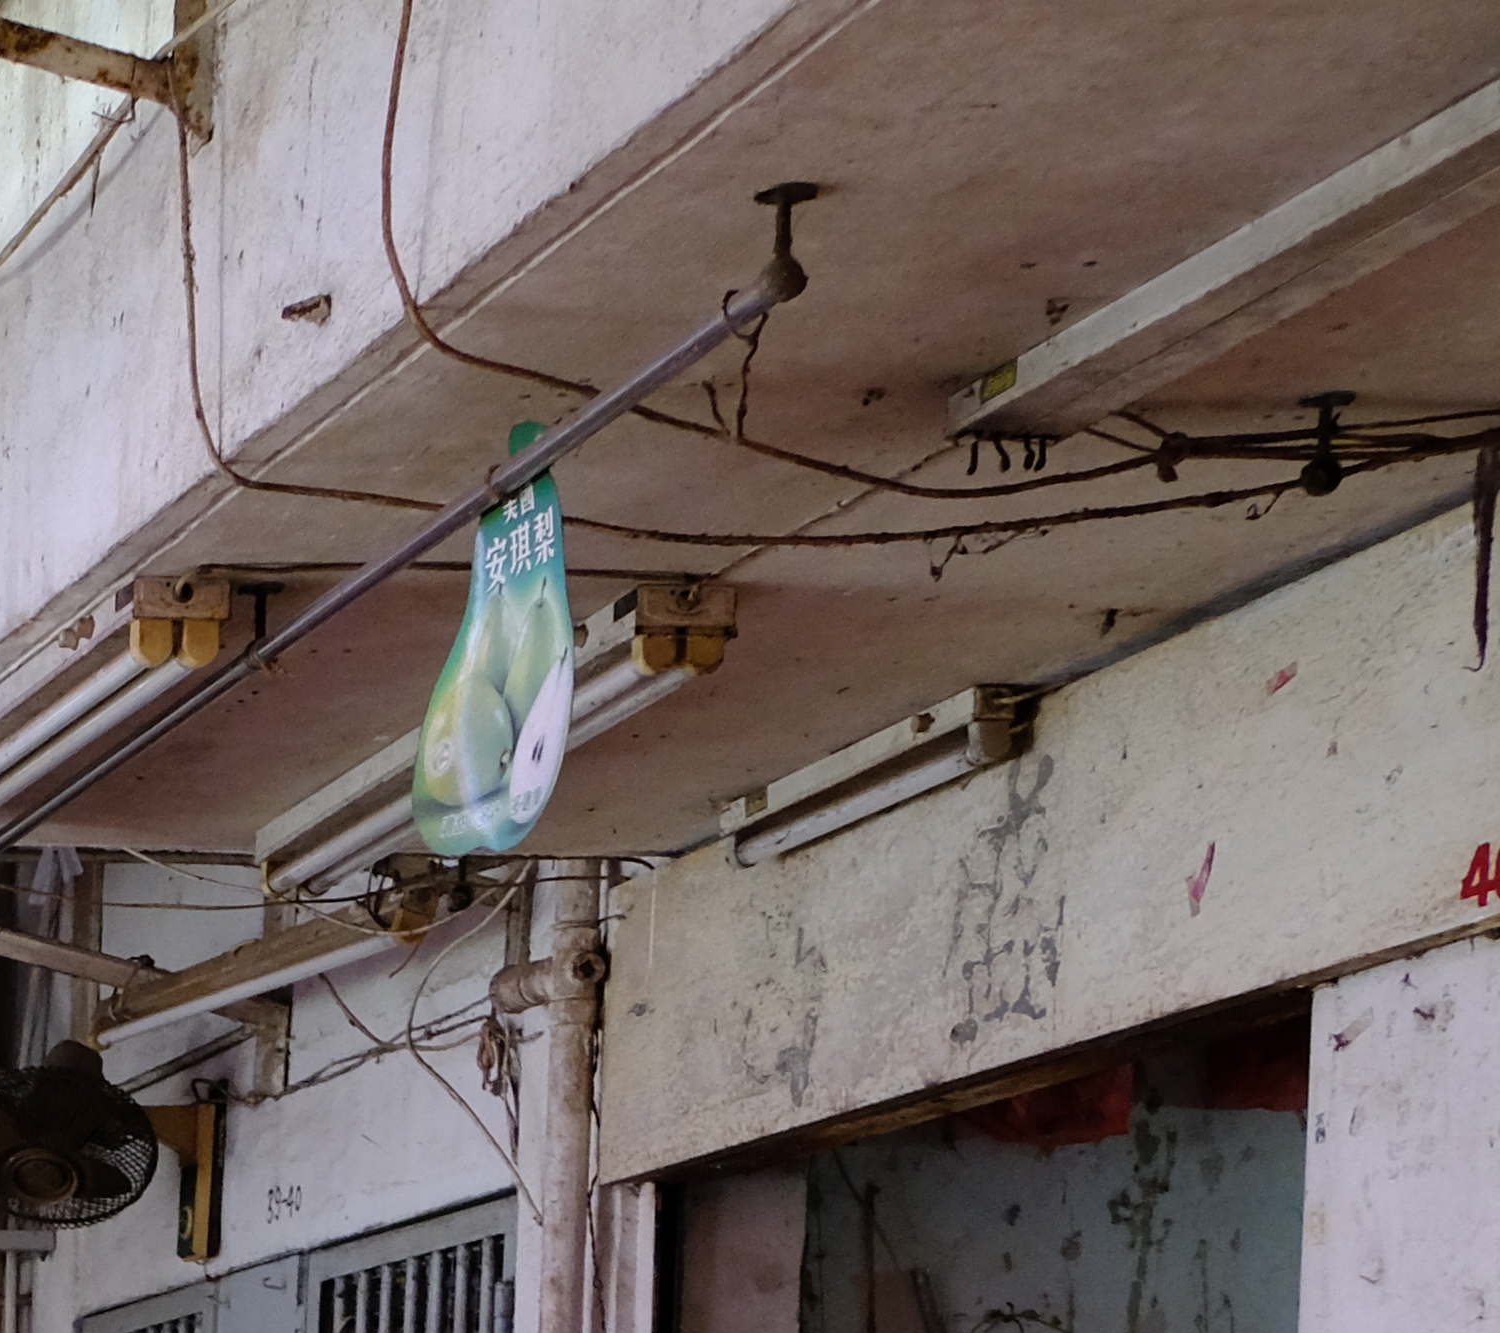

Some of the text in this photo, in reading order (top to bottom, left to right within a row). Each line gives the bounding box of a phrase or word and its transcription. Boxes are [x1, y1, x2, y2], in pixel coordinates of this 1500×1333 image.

[484, 504, 556, 593] 安琪梨
[1460, 842, 1500, 907] 4
